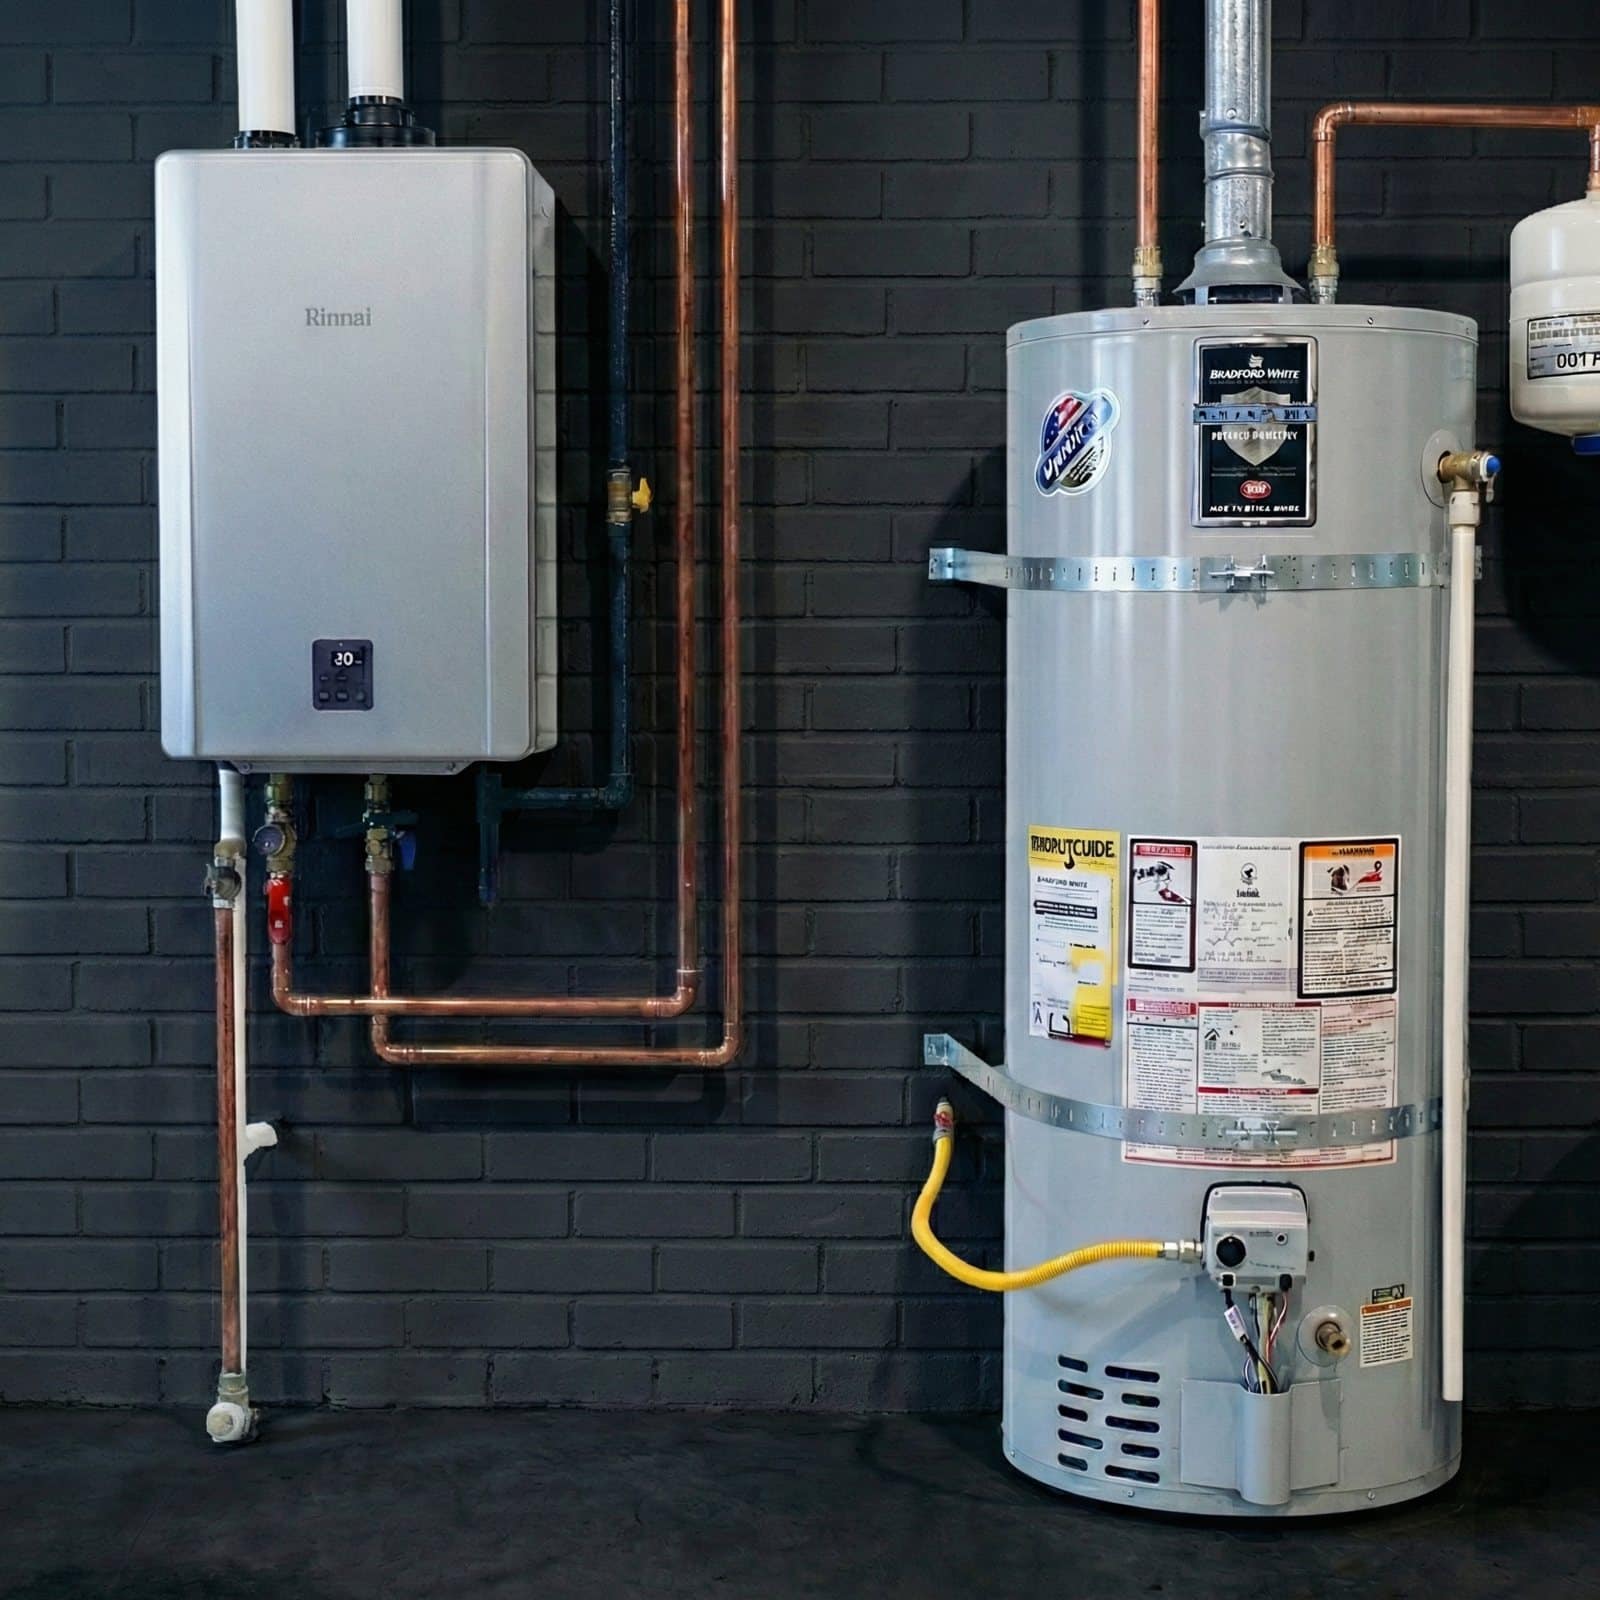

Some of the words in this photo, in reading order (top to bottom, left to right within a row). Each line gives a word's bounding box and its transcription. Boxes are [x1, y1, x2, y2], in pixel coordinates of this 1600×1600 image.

[305, 307, 371, 326] Rinnai
[1557, 352, 1586, 368] 001
[1210, 369, 1266, 379] BRADFORD
[1267, 368, 1301, 379] WHITE
